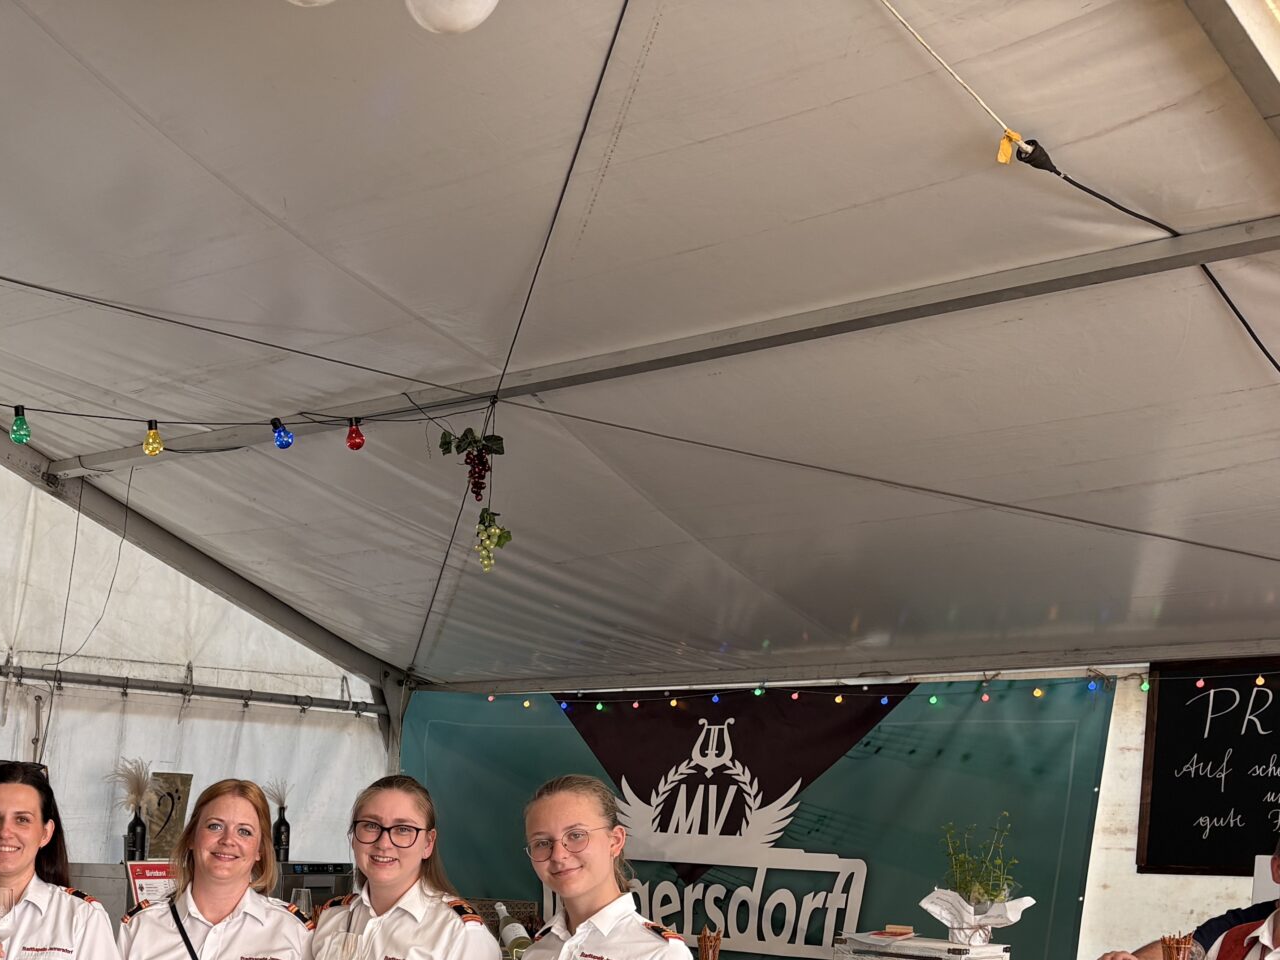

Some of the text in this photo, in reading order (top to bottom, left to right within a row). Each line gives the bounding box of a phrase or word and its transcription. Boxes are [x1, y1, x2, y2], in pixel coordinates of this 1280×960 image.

[1174, 747, 1233, 793] Auf
[668, 783, 739, 836] MV
[1192, 807, 1246, 840] gute
